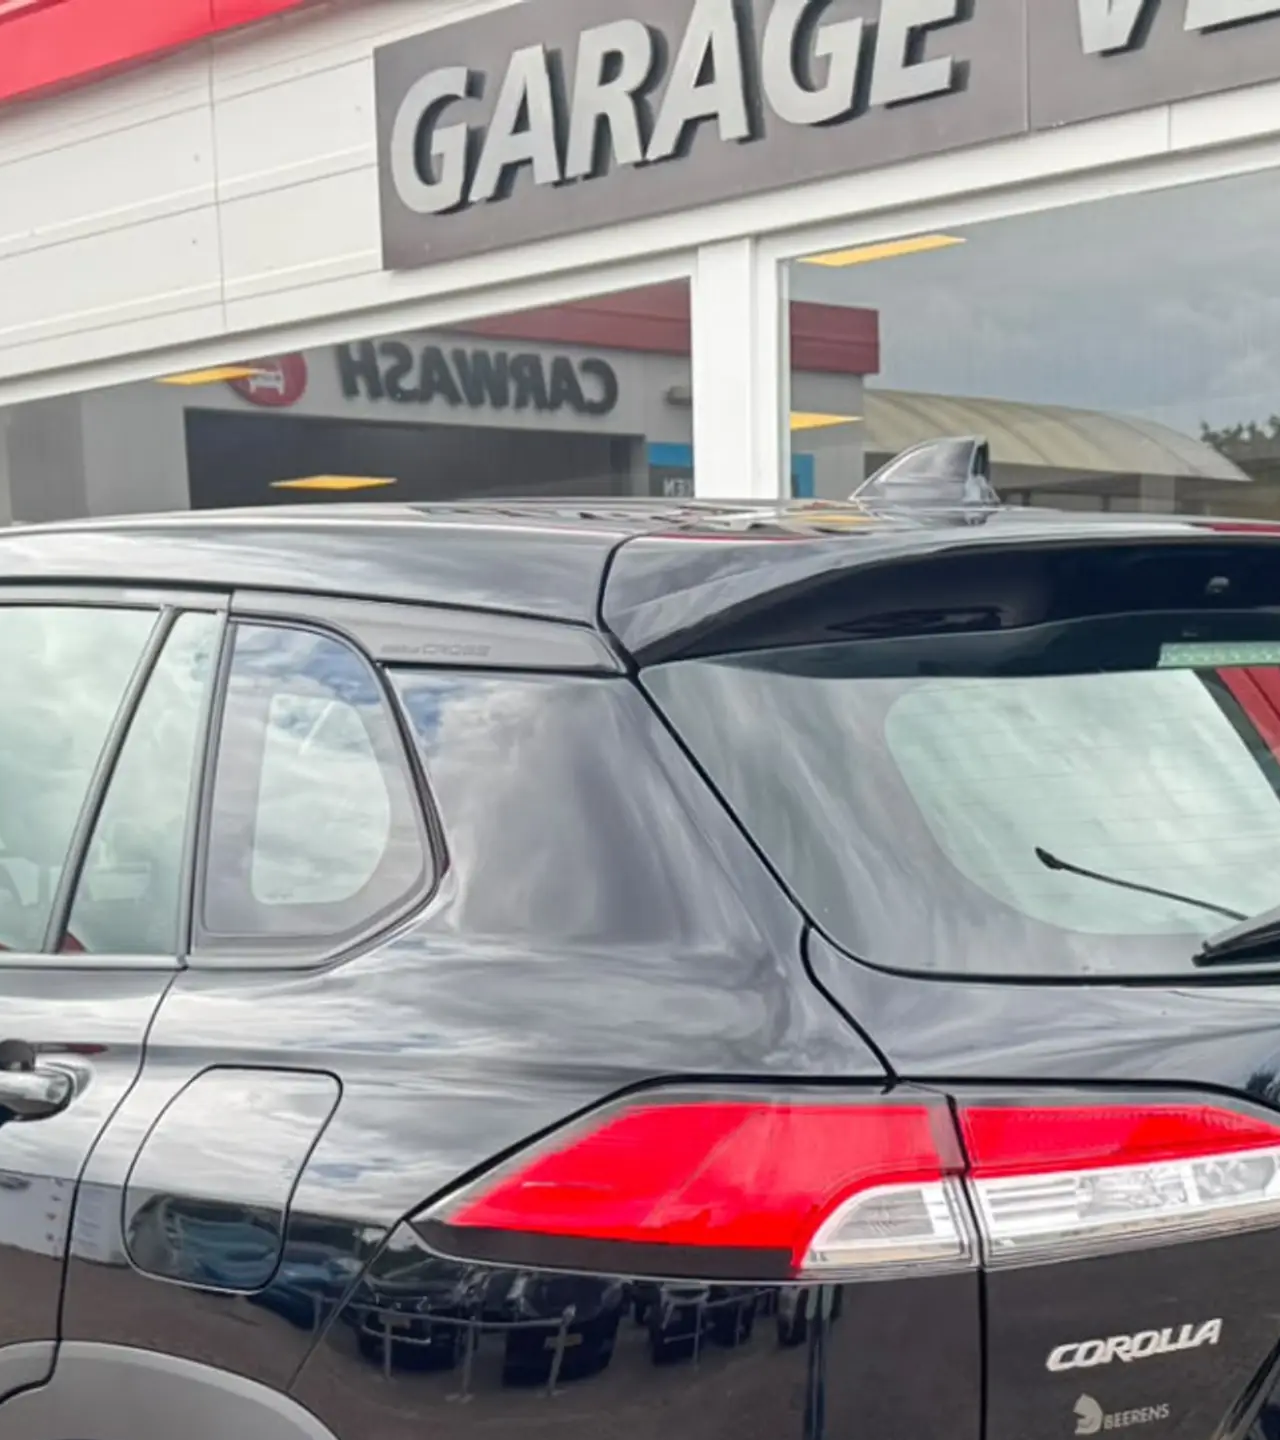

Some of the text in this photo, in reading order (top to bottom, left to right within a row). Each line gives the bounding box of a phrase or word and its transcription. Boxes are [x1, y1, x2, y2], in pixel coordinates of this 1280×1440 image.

[391, 0, 960, 215] GARAGE
[1045, 1318, 1223, 1372] COROLLA
[1103, 1403, 1170, 1431] BEERENS
